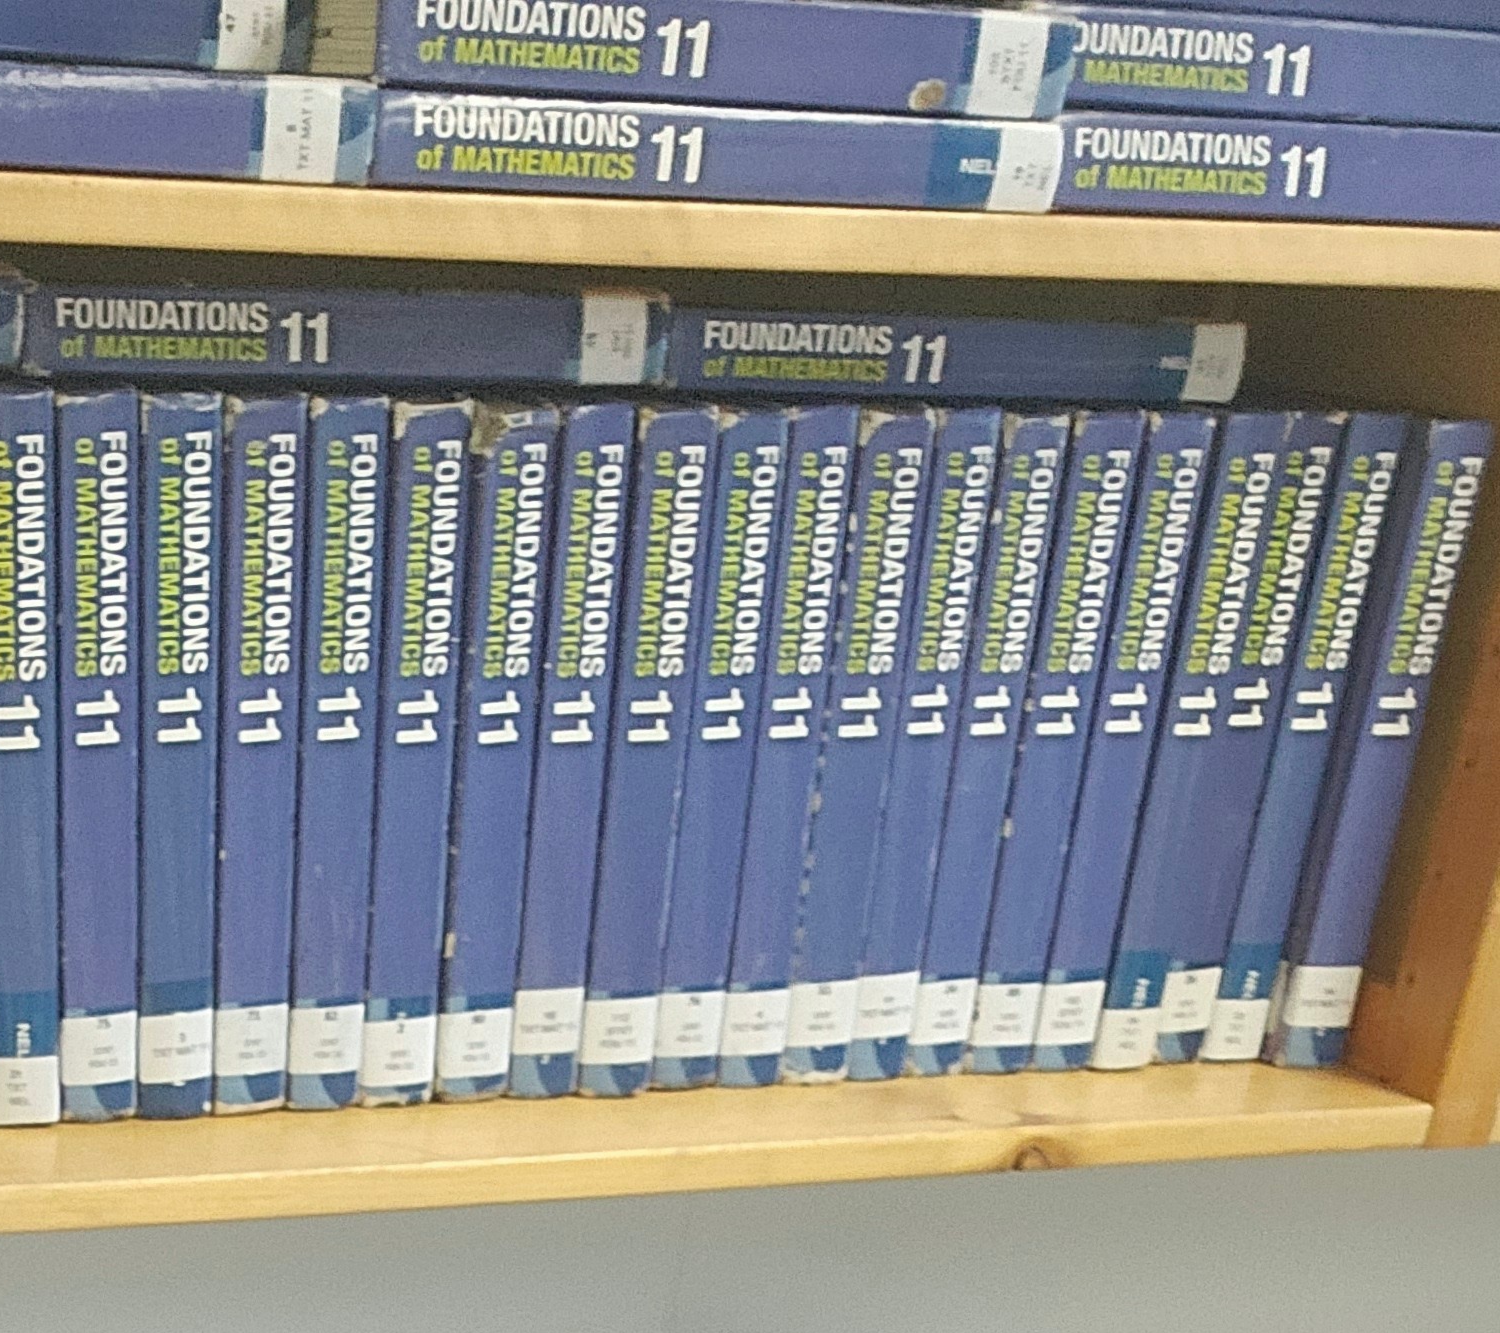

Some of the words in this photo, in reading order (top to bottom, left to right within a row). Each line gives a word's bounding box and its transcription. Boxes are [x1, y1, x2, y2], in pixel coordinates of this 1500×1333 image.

[417, 0, 647, 41] FOUNDATIONS
[1072, 21, 1253, 63] OUNDATIONS
[419, 35, 447, 62] of
[455, 38, 641, 75] MATHEMATICS
[657, 18, 710, 78] 11
[1263, 43, 1311, 96] 11
[1085, 59, 1249, 93] MATHEMATICS
[414, 103, 640, 149] FOUNDATIONS
[1075, 127, 1271, 166] FOUNDATIONS
[416, 144, 444, 170] of
[453, 145, 636, 181] MATHEMATICS
[652, 125, 703, 183] 11
[1075, 165, 1100, 188] of
[1107, 165, 1267, 195] MATHEMATICS
[1280, 145, 1327, 198] 11
[55, 297, 269, 333] FOUNDATIONS
[280, 311, 329, 363] 11
[704, 319, 893, 355] FOUNDATIONS
[61, 334, 85, 358] of
[94, 335, 267, 362] MATHEMATICS
[732, 355, 888, 382] MATHEMATICS
[901, 335, 946, 383] 11
[77, 439, 96, 464] of
[159, 439, 181, 464] of
[245, 443, 265, 467] of
[16, 435, 47, 681] FOUNDATIONS
[77, 478, 98, 676] MATHEMATICS
[100, 431, 127, 676] FOUNDATIONS
[159, 477, 181, 674] MATHEMATICS
[182, 431, 212, 673] FOUNDATIONS
[242, 480, 265, 675] MATHEMATICS
[263, 434, 296, 675] FOUNDATIONS
[321, 480, 347, 673] MATHEMATICS
[343, 434, 377, 673] FOUNDATIONS
[423, 440, 462, 676] FOUNDATIONS
[505, 443, 547, 677] FOUNDATIONS
[579, 444, 624, 678] FOUNDATIONS
[658, 446, 706, 677] FOUNDATIONS
[730, 446, 780, 676] FOUNDATIONS
[798, 446, 849, 674] FOUNDATIONS
[867, 448, 922, 674] FOUNDATIONS
[937, 446, 993, 672] FOUNDATIONS
[1000, 449, 1058, 673] FOUNDATIONS
[1068, 450, 1131, 673] FOUNDATIONS
[1138, 449, 1203, 671] FOUNDATIONS
[1208, 453, 1275, 674] FOUNDATIONS
[1260, 447, 1331, 666] FOUNDATIONS
[1325, 451, 1396, 670] FOUNDATIONS
[1409, 457, 1482, 675] FOUNDATIONS
[401, 485, 431, 676] MATHEMATICS
[485, 488, 516, 677] MATHEMATICS
[559, 489, 592, 677] MATHEMATICS
[636, 489, 673, 676] MATHEMATICS
[711, 490, 748, 674] MATHEMATICS
[779, 490, 816, 673] MATHEMATICS
[848, 490, 889, 673] MATHEMATICS
[76, 690, 120, 745] 11
[157, 688, 202, 742] 11
[238, 688, 282, 743] 11
[317, 687, 361, 741] 11
[396, 690, 439, 743] 11
[478, 691, 520, 744] 11
[551, 691, 595, 743] 11
[628, 690, 673, 742] 11
[702, 688, 744, 739] 11
[769, 687, 812, 738] 11
[838, 687, 881, 737] 11
[906, 684, 948, 734] 11
[970, 686, 1010, 735] 11
[1035, 686, 1079, 735] 11
[1104, 683, 1147, 733] 11
[1173, 687, 1216, 736] 11
[1228, 678, 1269, 726] 11
[1290, 682, 1333, 730] 11
[1371, 687, 1416, 735] 11
